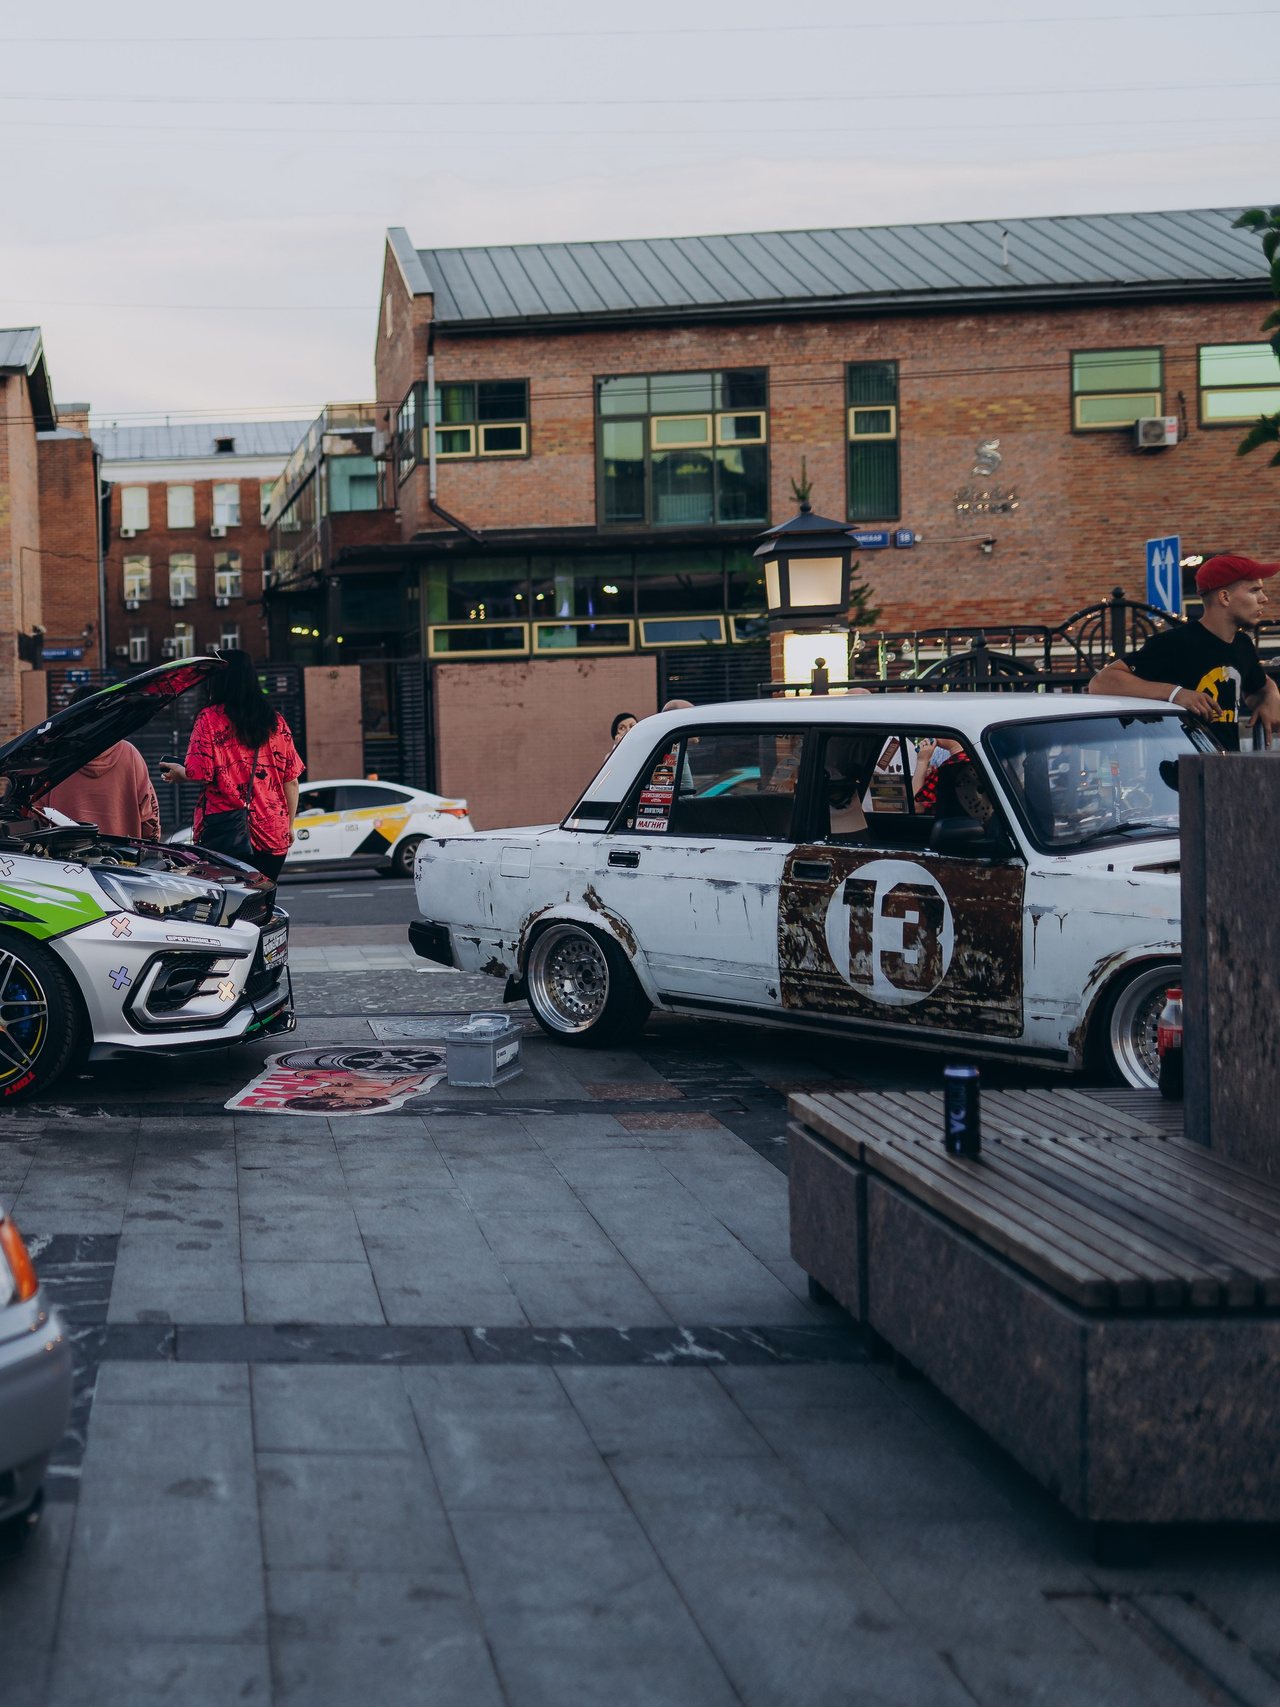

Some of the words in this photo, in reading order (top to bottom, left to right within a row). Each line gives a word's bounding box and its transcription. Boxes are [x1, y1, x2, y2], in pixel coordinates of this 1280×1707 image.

[637, 820, 666, 830] МАГНИТ
[843, 878, 945, 993] 13
[4, 1071, 36, 1096] TONY
